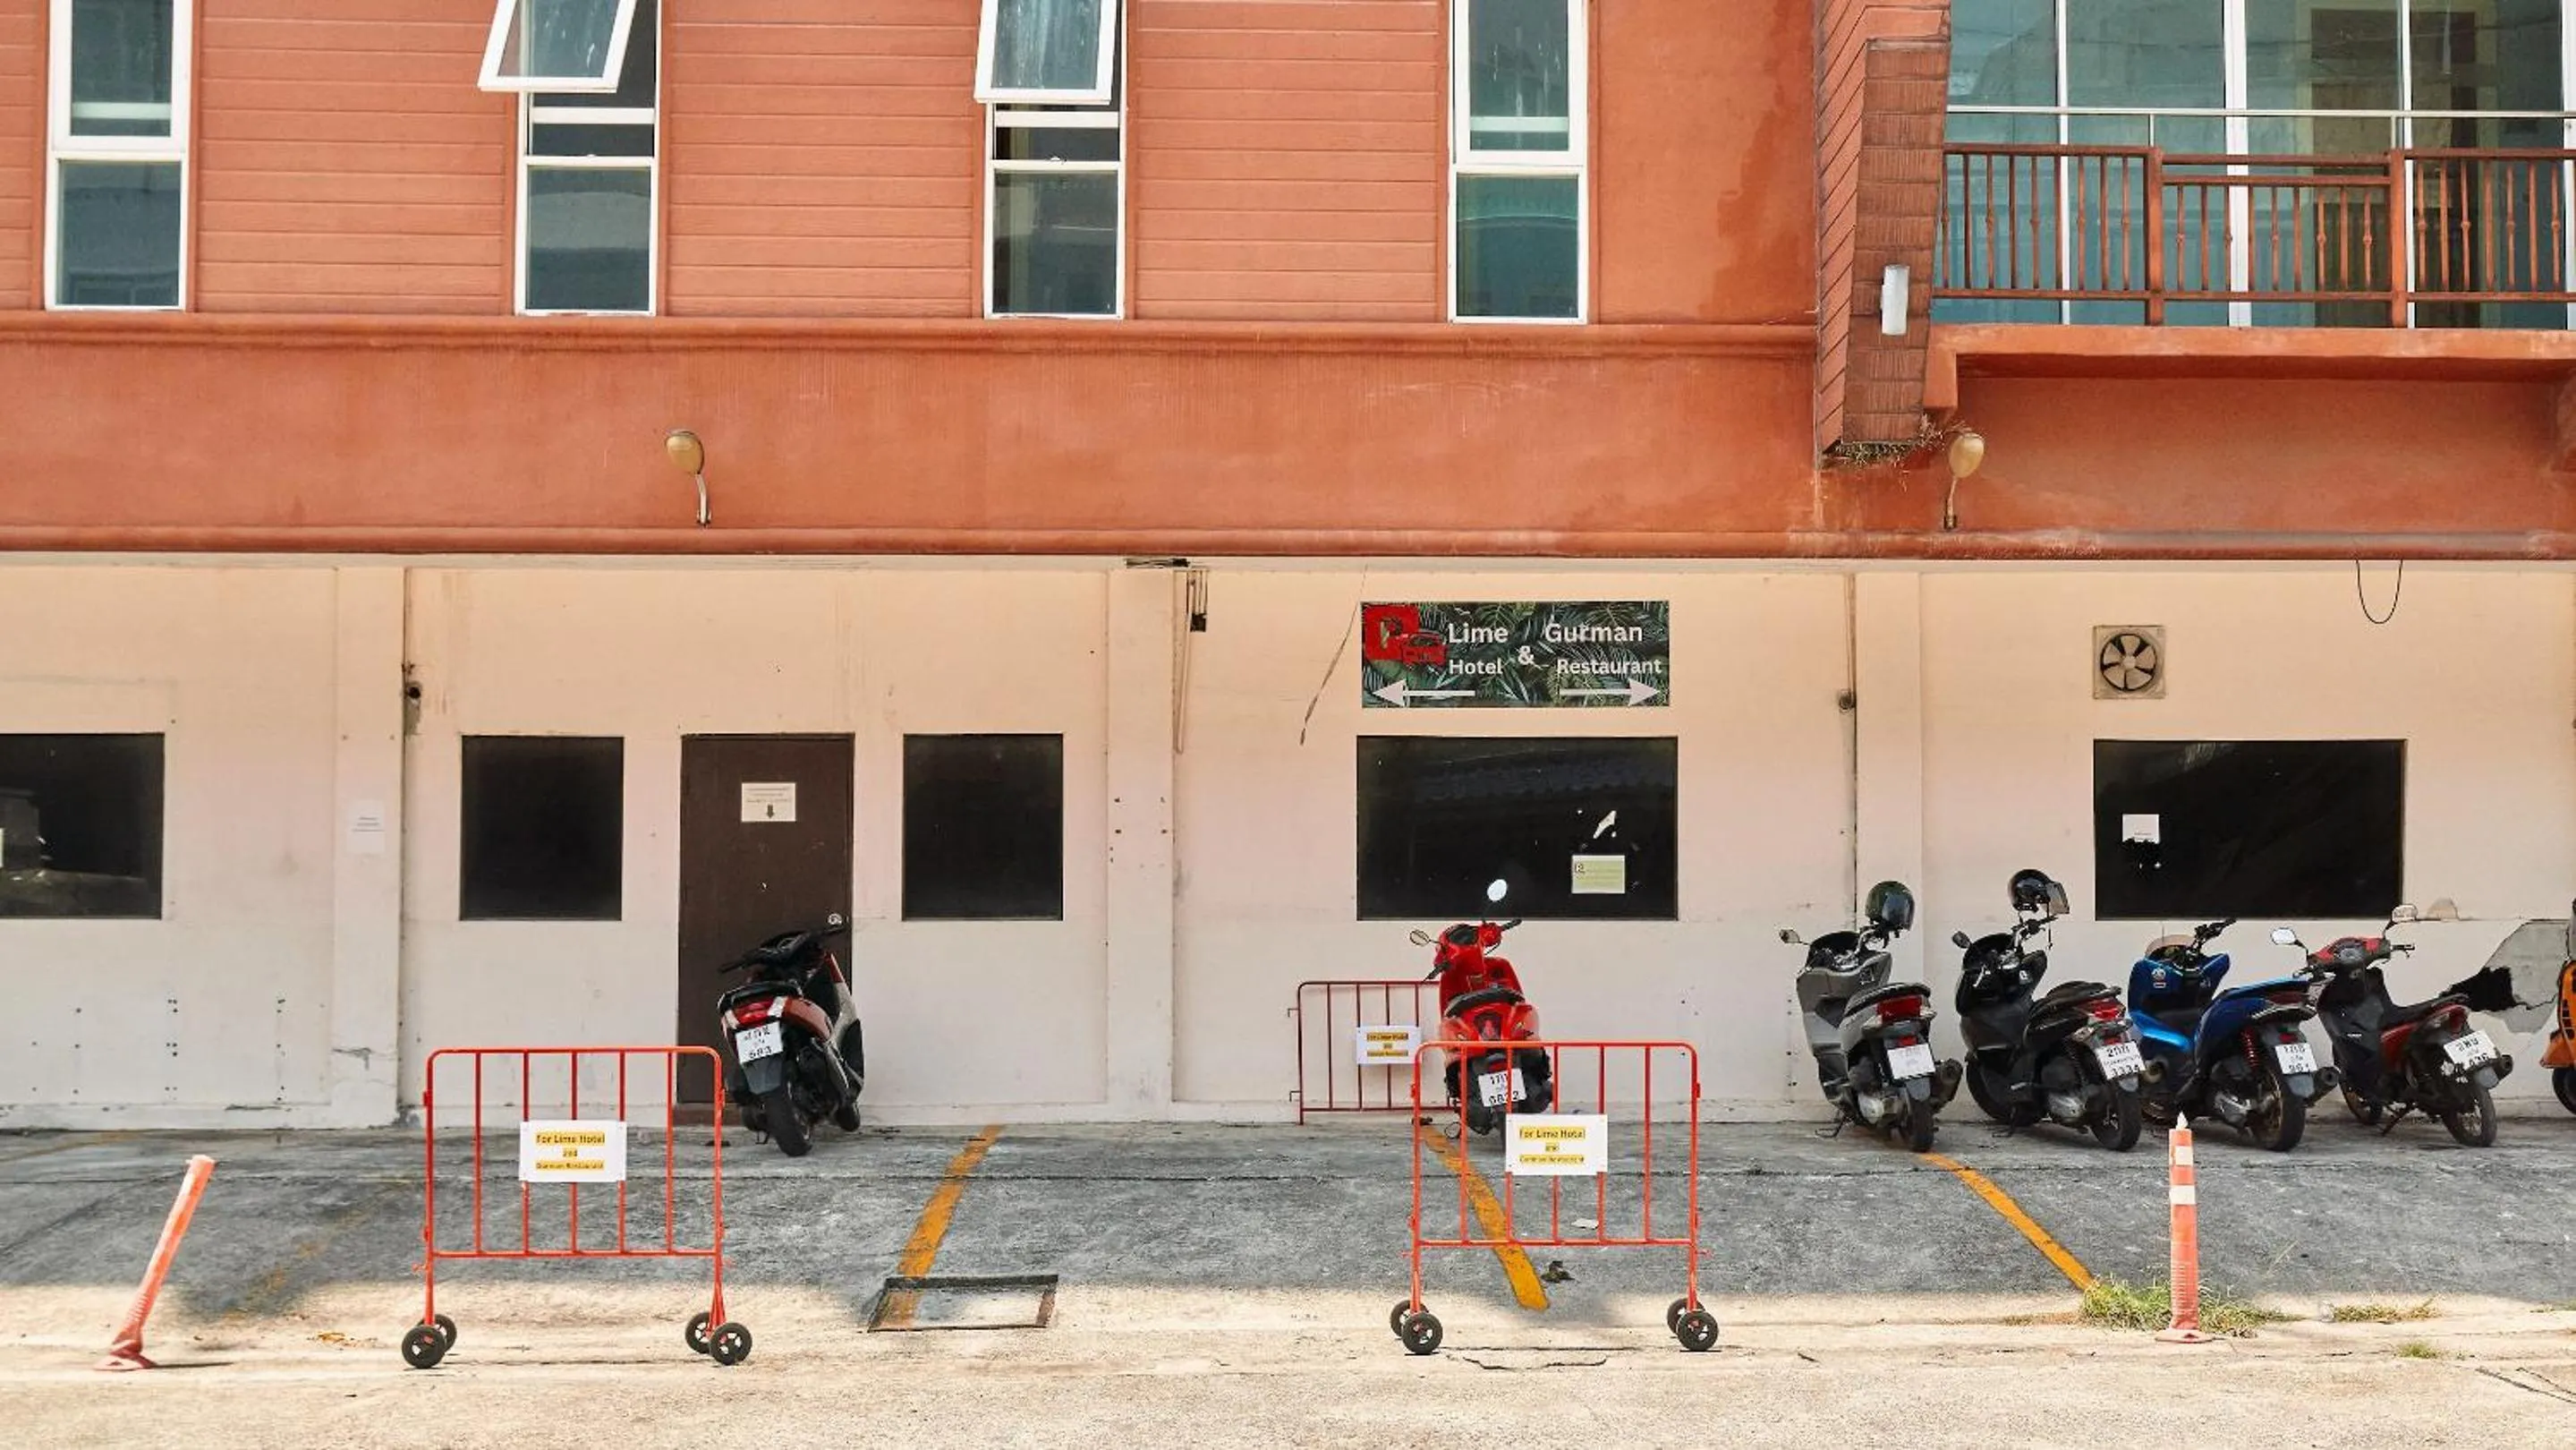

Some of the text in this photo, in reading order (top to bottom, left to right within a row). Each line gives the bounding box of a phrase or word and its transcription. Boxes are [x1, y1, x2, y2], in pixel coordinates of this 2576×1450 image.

[1448, 623, 1509, 644] Lime
[1544, 623, 1644, 644] Gurman
[1517, 645, 1535, 666] &
[1449, 658, 1504, 675] Hotel
[1557, 658, 1662, 675] Restaurant
[536, 1133, 606, 1144] For Lime Hotel
[1519, 1129, 1586, 1139] For Lime Hotel
